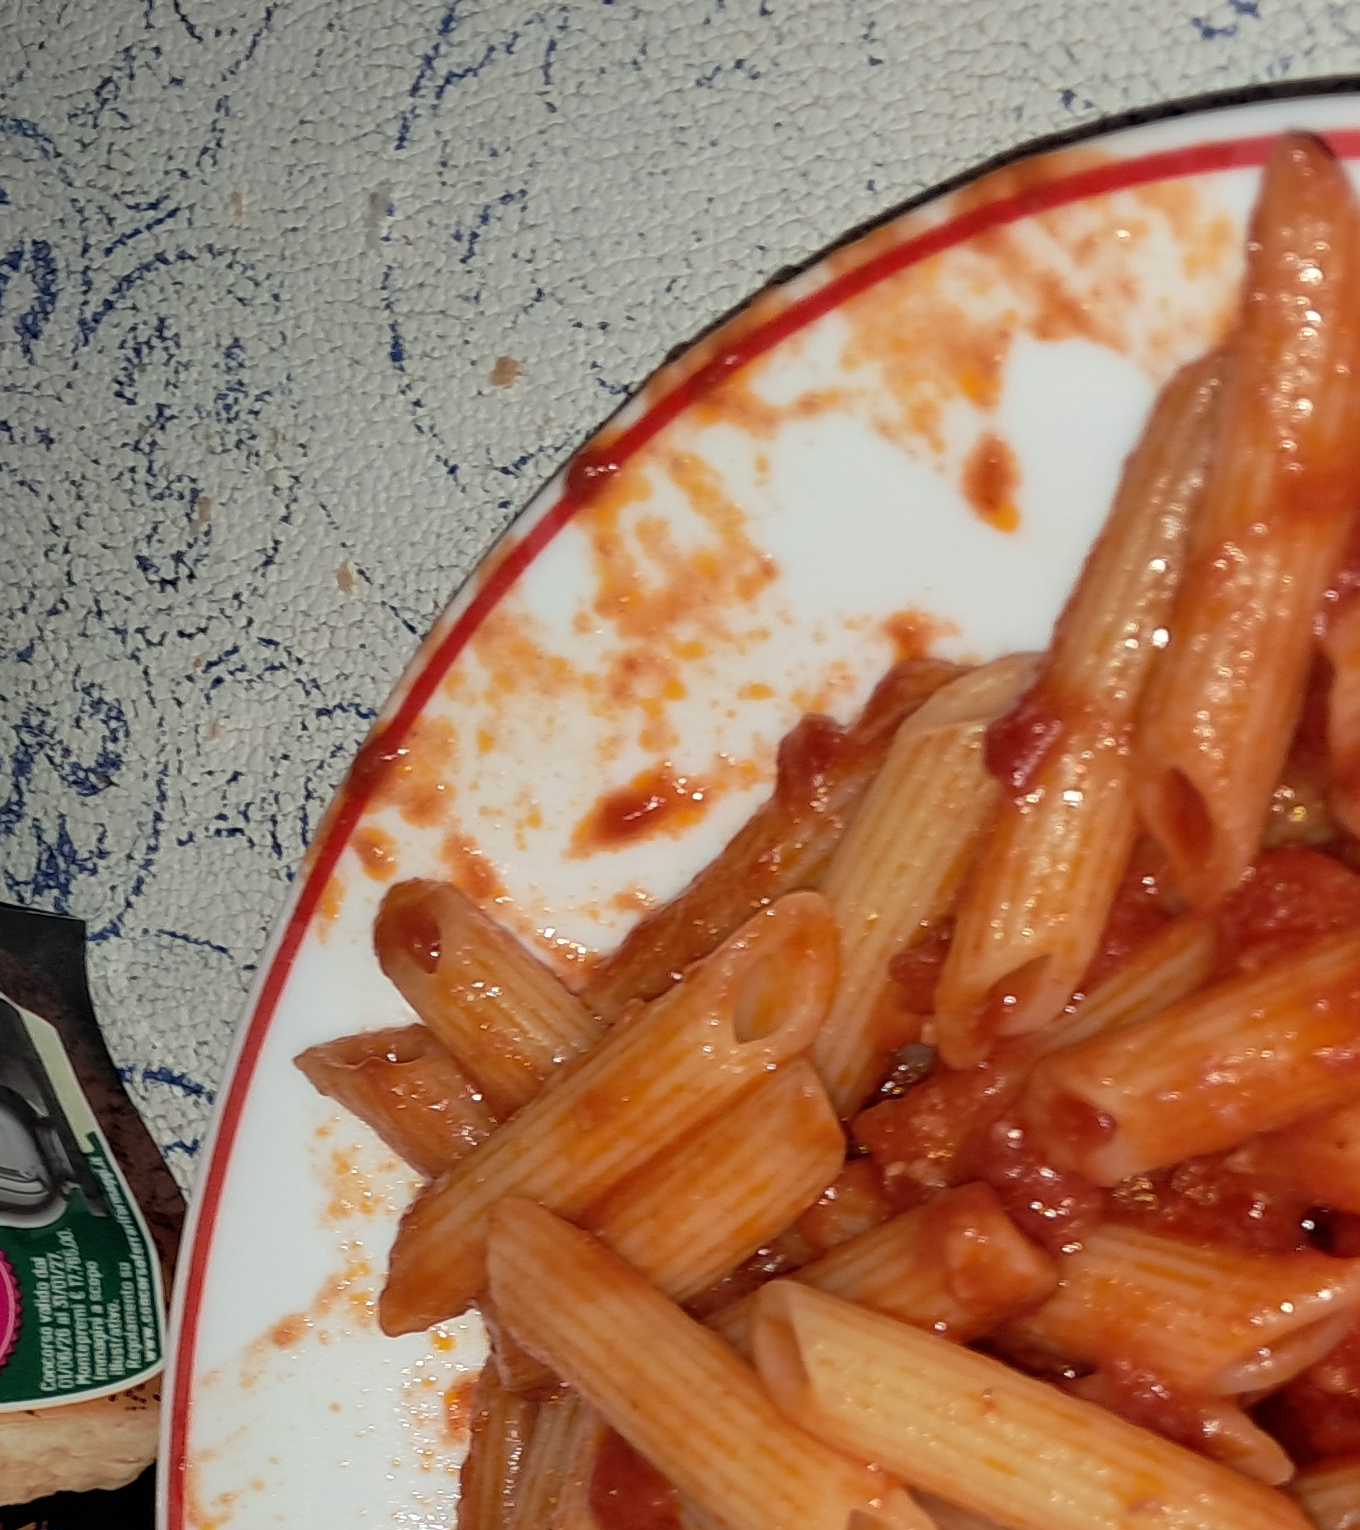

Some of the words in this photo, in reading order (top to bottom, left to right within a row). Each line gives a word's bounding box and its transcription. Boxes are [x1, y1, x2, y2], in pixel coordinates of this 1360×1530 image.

[29, 1257, 49, 1278] dal
[85, 1261, 104, 1301] scopo
[118, 1262, 133, 1278] su
[32, 1281, 53, 1323] valido
[90, 1304, 105, 1314] a
[70, 1304, 93, 1384] Montepremi
[120, 1281, 144, 1368] Regolamento
[39, 1327, 56, 1391] Concorso
[88, 1317, 109, 1380] Immagini
